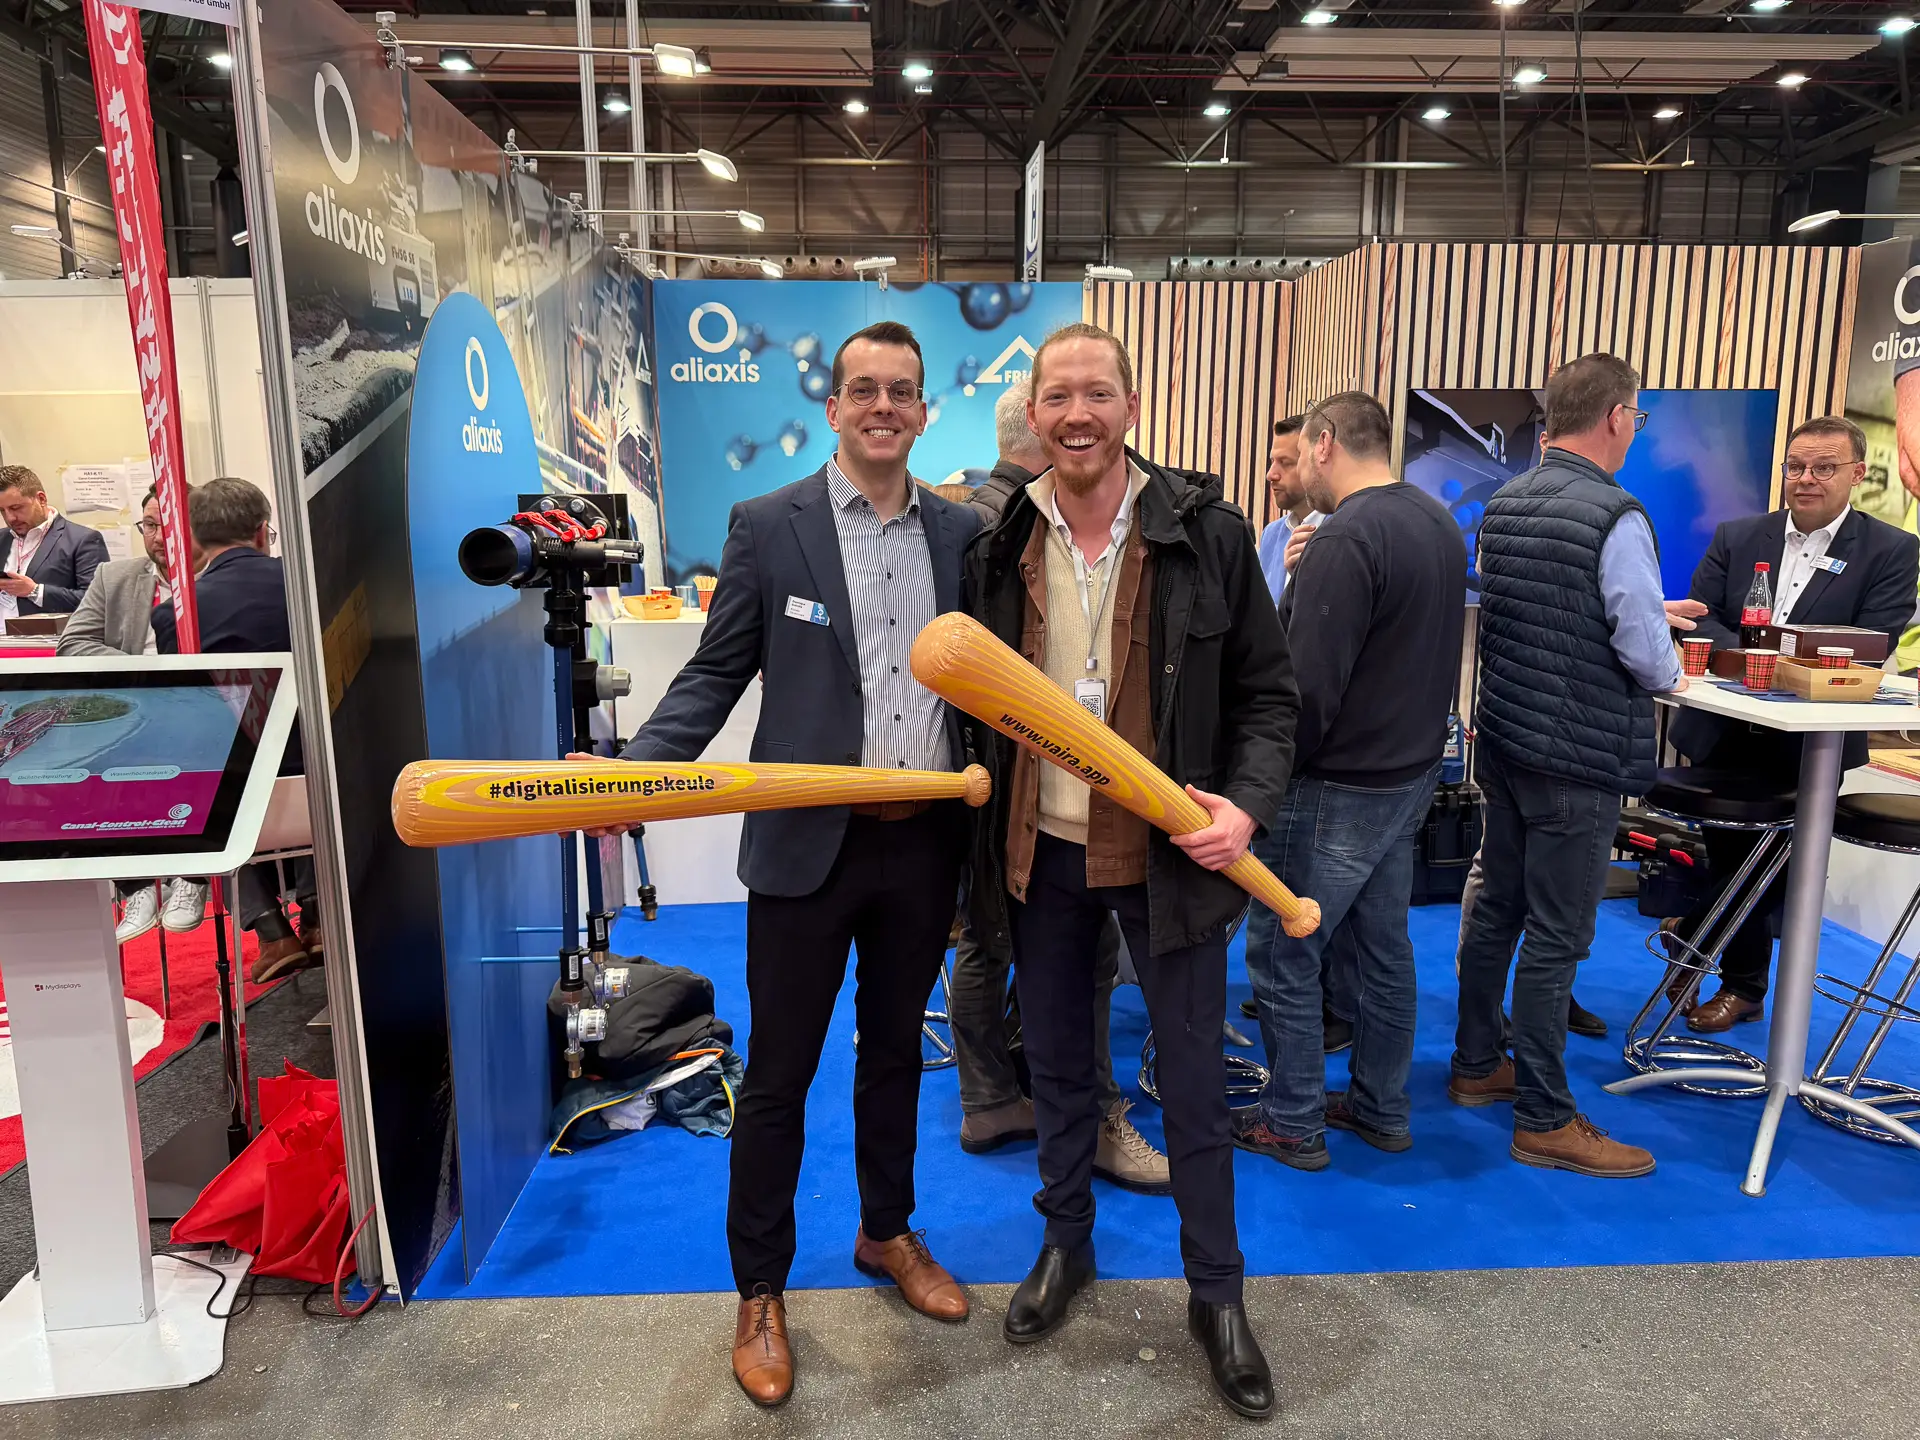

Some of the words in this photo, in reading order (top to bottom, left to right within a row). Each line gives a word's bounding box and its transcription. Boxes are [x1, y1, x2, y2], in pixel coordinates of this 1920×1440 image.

[206, 0, 231, 11] GmbH
[305, 183, 387, 266] aliaxis
[670, 357, 760, 383] aliaxis
[462, 415, 503, 454] aliaxis
[1000, 713, 1111, 786] www.vaira.app
[489, 775, 715, 800] #digitalisierungskeule
[45, 983, 82, 991] Mydisplays
